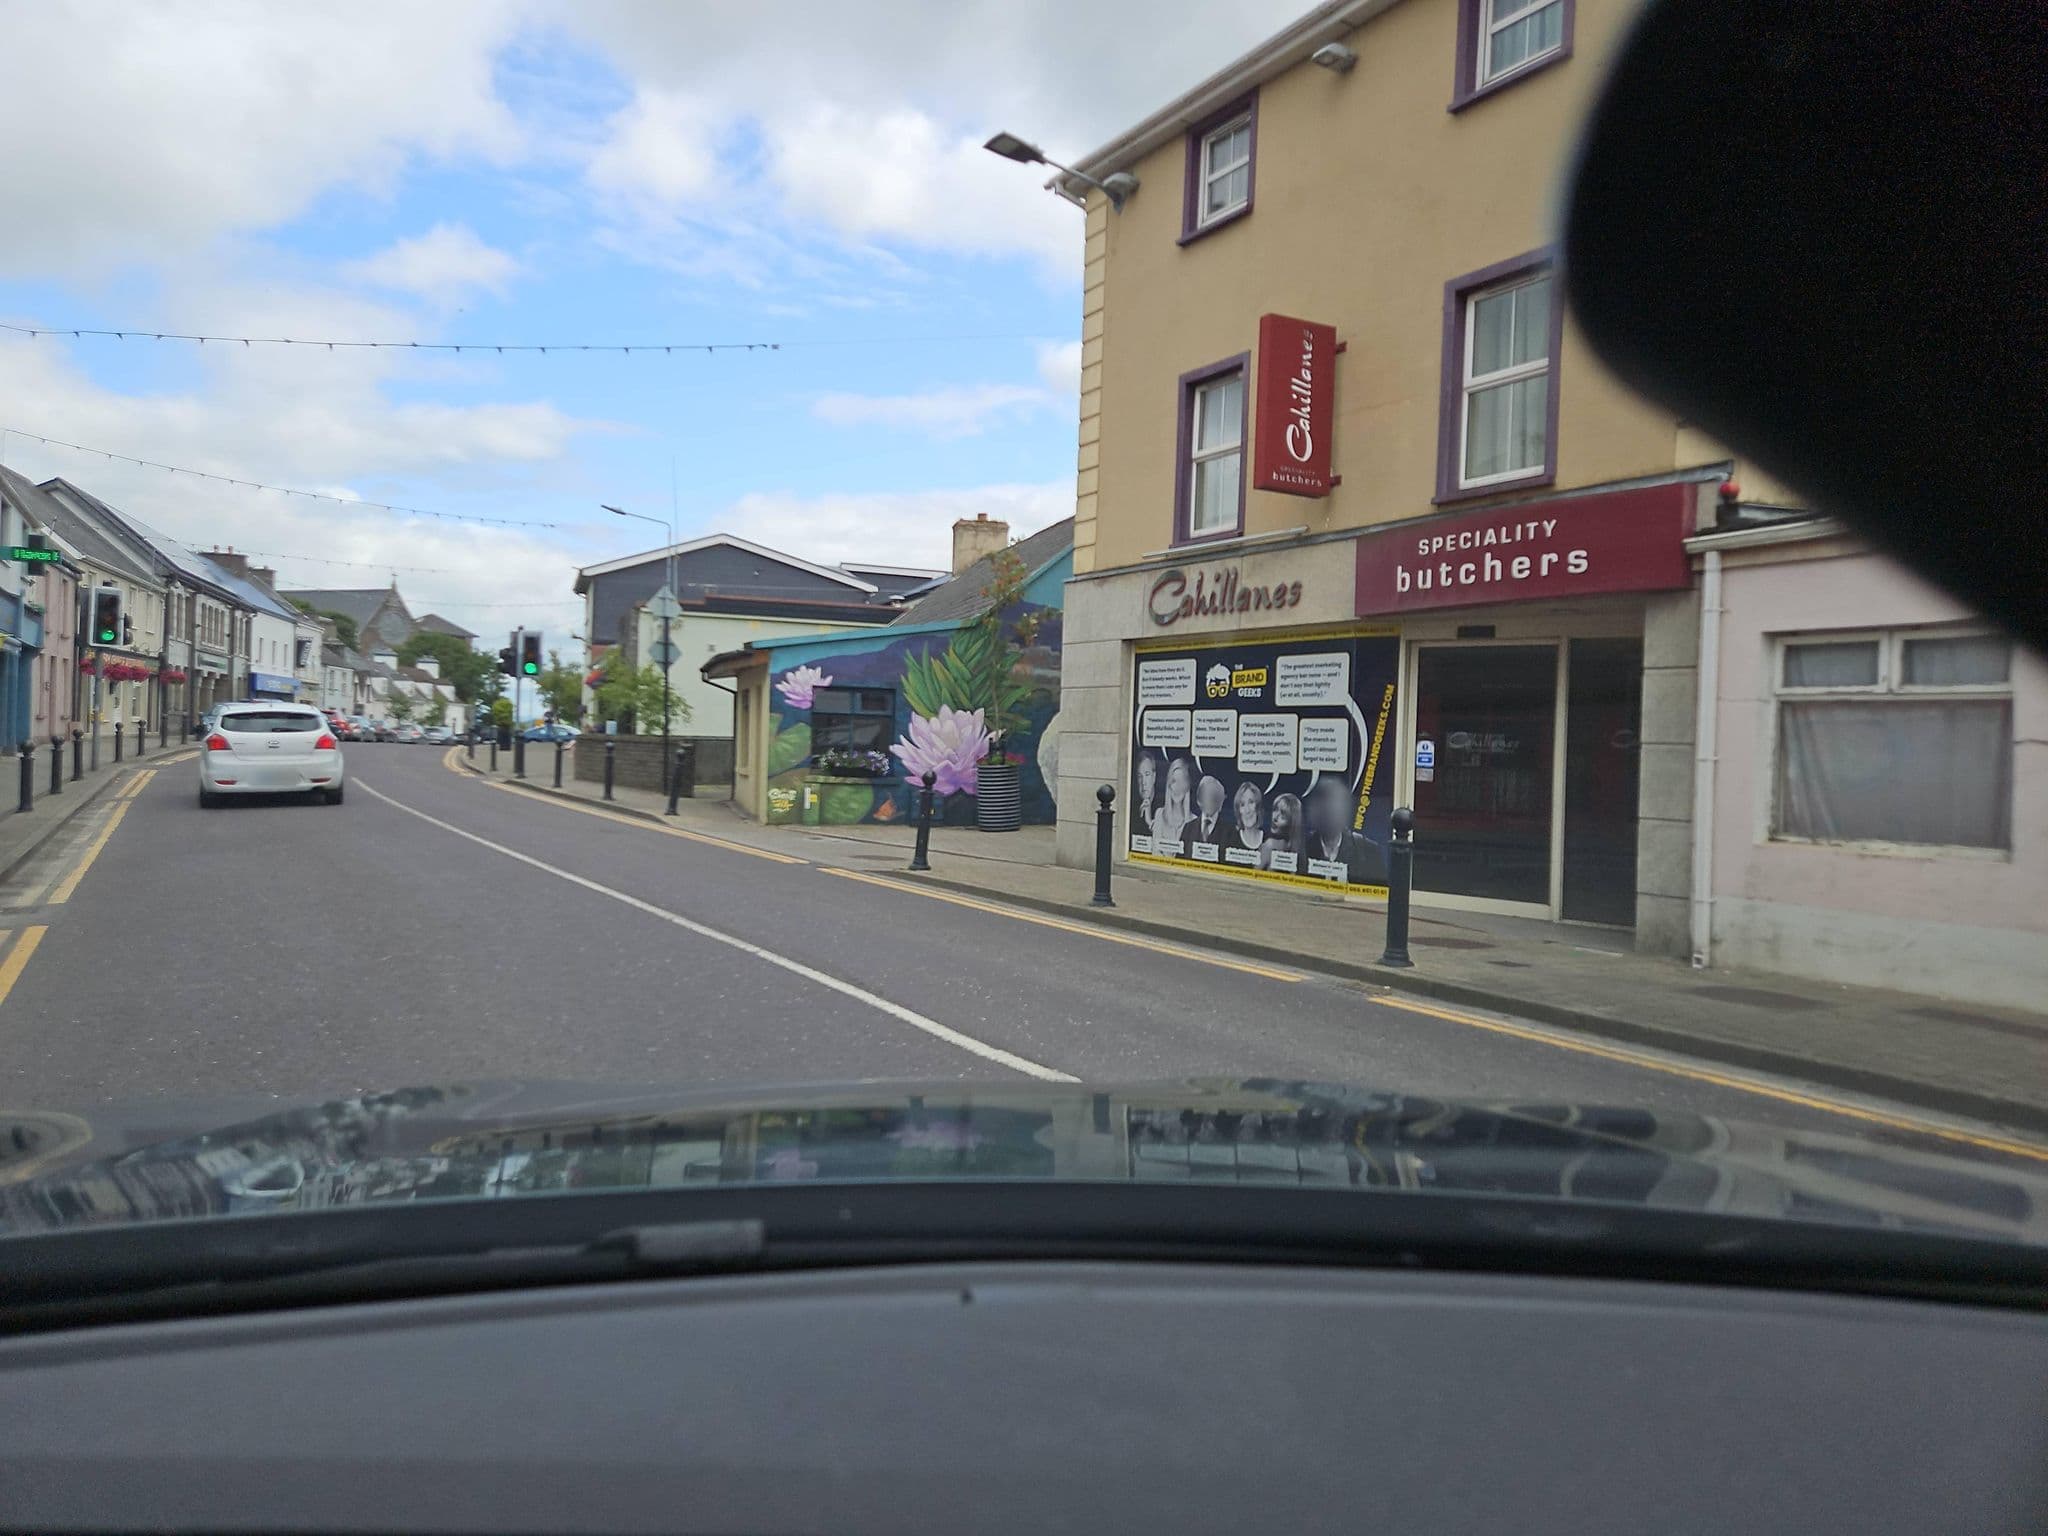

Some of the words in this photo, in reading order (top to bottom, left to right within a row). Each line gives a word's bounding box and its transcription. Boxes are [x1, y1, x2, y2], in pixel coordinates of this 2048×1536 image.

[1286, 329, 1314, 463] Cahillanes
[1272, 471, 1323, 489] butchers
[1418, 518, 1558, 557] SPECIALITY
[1396, 549, 1590, 593] butchers
[1149, 566, 1303, 627] Cahillanes
[1235, 671, 1265, 686] BRAND
[1237, 686, 1262, 698] GEEKS
